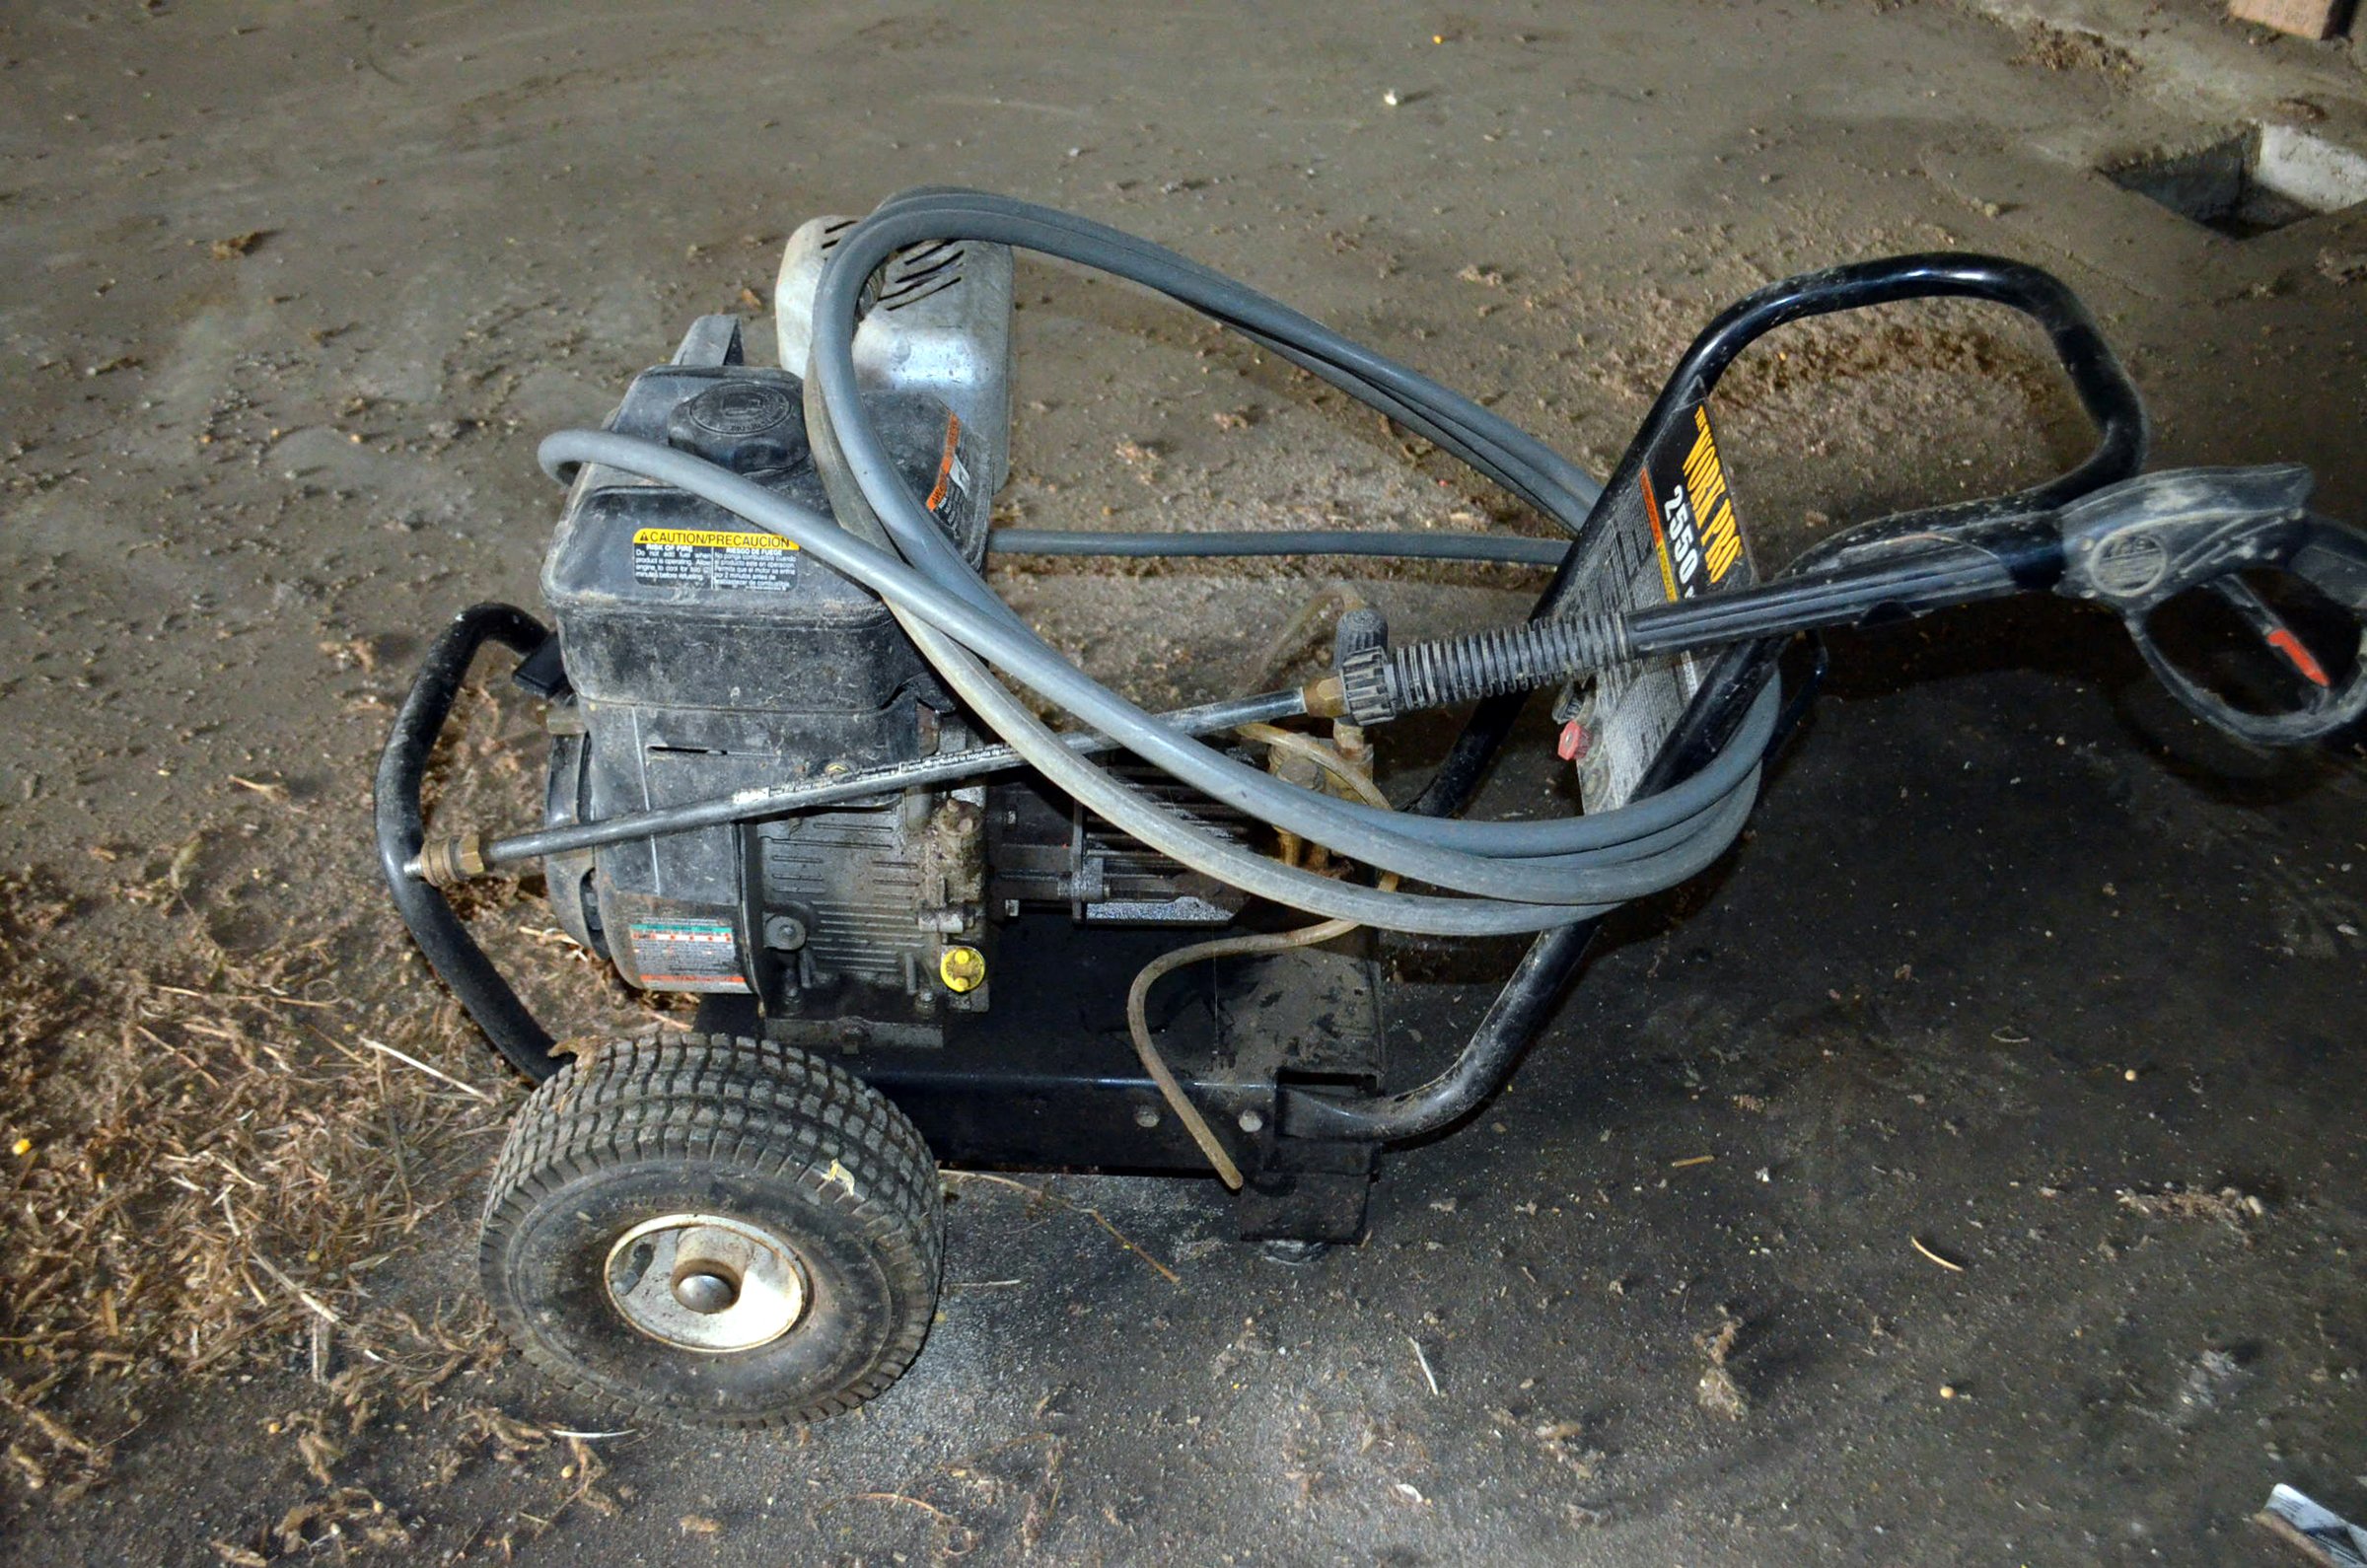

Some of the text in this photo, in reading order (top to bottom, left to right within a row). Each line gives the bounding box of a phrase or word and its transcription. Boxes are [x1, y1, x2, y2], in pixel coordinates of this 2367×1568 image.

[1664, 484, 1698, 584] 2550
[1683, 405, 1741, 584] THE WORK PRO
